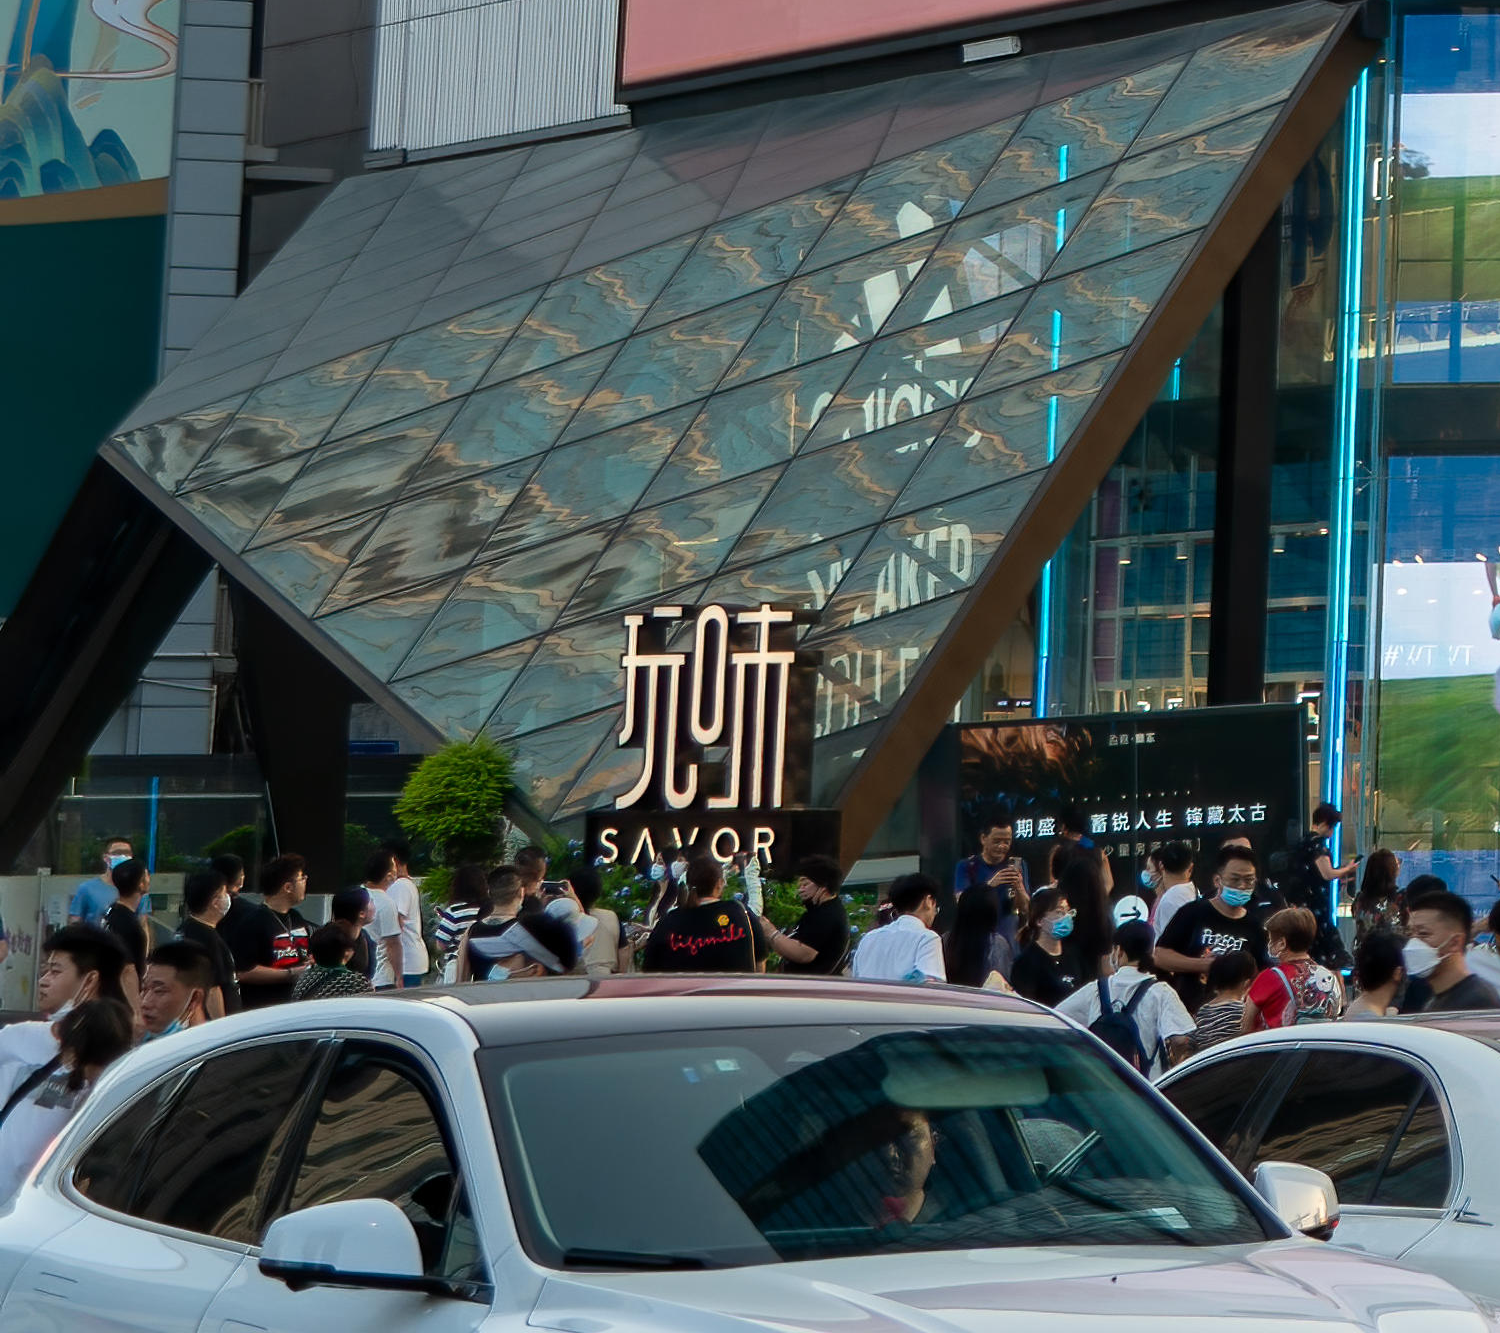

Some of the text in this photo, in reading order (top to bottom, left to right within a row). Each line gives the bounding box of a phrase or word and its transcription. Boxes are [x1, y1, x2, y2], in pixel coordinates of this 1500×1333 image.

[1015, 802, 1268, 840] 期盛 蓄锐人生 锋藏太古
[599, 826, 776, 865] SAVOR
